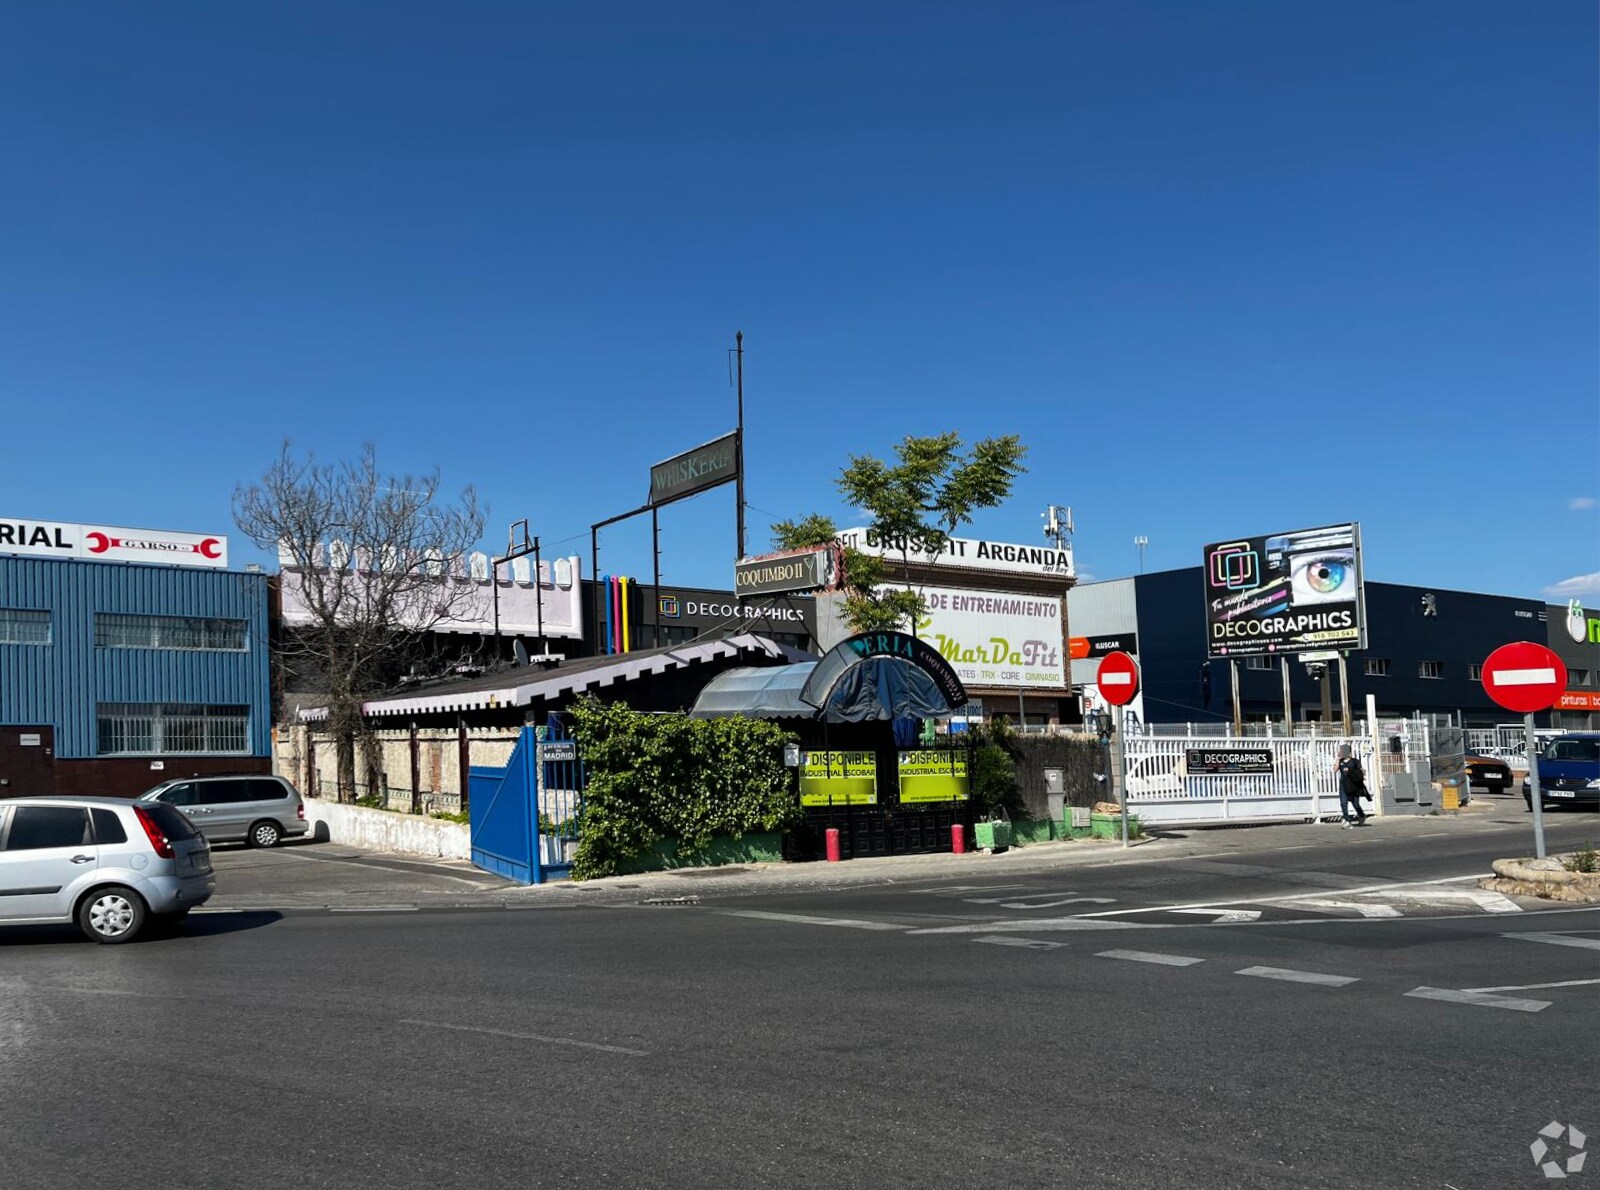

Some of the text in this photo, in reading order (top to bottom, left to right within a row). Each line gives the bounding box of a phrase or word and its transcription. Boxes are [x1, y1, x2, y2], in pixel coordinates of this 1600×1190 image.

[125, 540, 177, 552] GARSO
[976, 541, 1069, 567] ARGANDA
[1043, 564, 1069, 576] del Rey
[736, 565, 793, 588] COQUIMBO
[930, 593, 948, 610] DE
[952, 595, 1057, 618] ENTRENAMIENTO
[1213, 611, 1352, 638] DECOGRAPHICS
[981, 671, 996, 680] TRX
[1001, 671, 1020, 681] CORE
[1025, 672, 1060, 683] GIMNASIO
[811, 753, 875, 766] DISPONIBLE
[1204, 753, 1267, 764] DECOGRAPHICS
[843, 769, 875, 777] ESCOBAR
